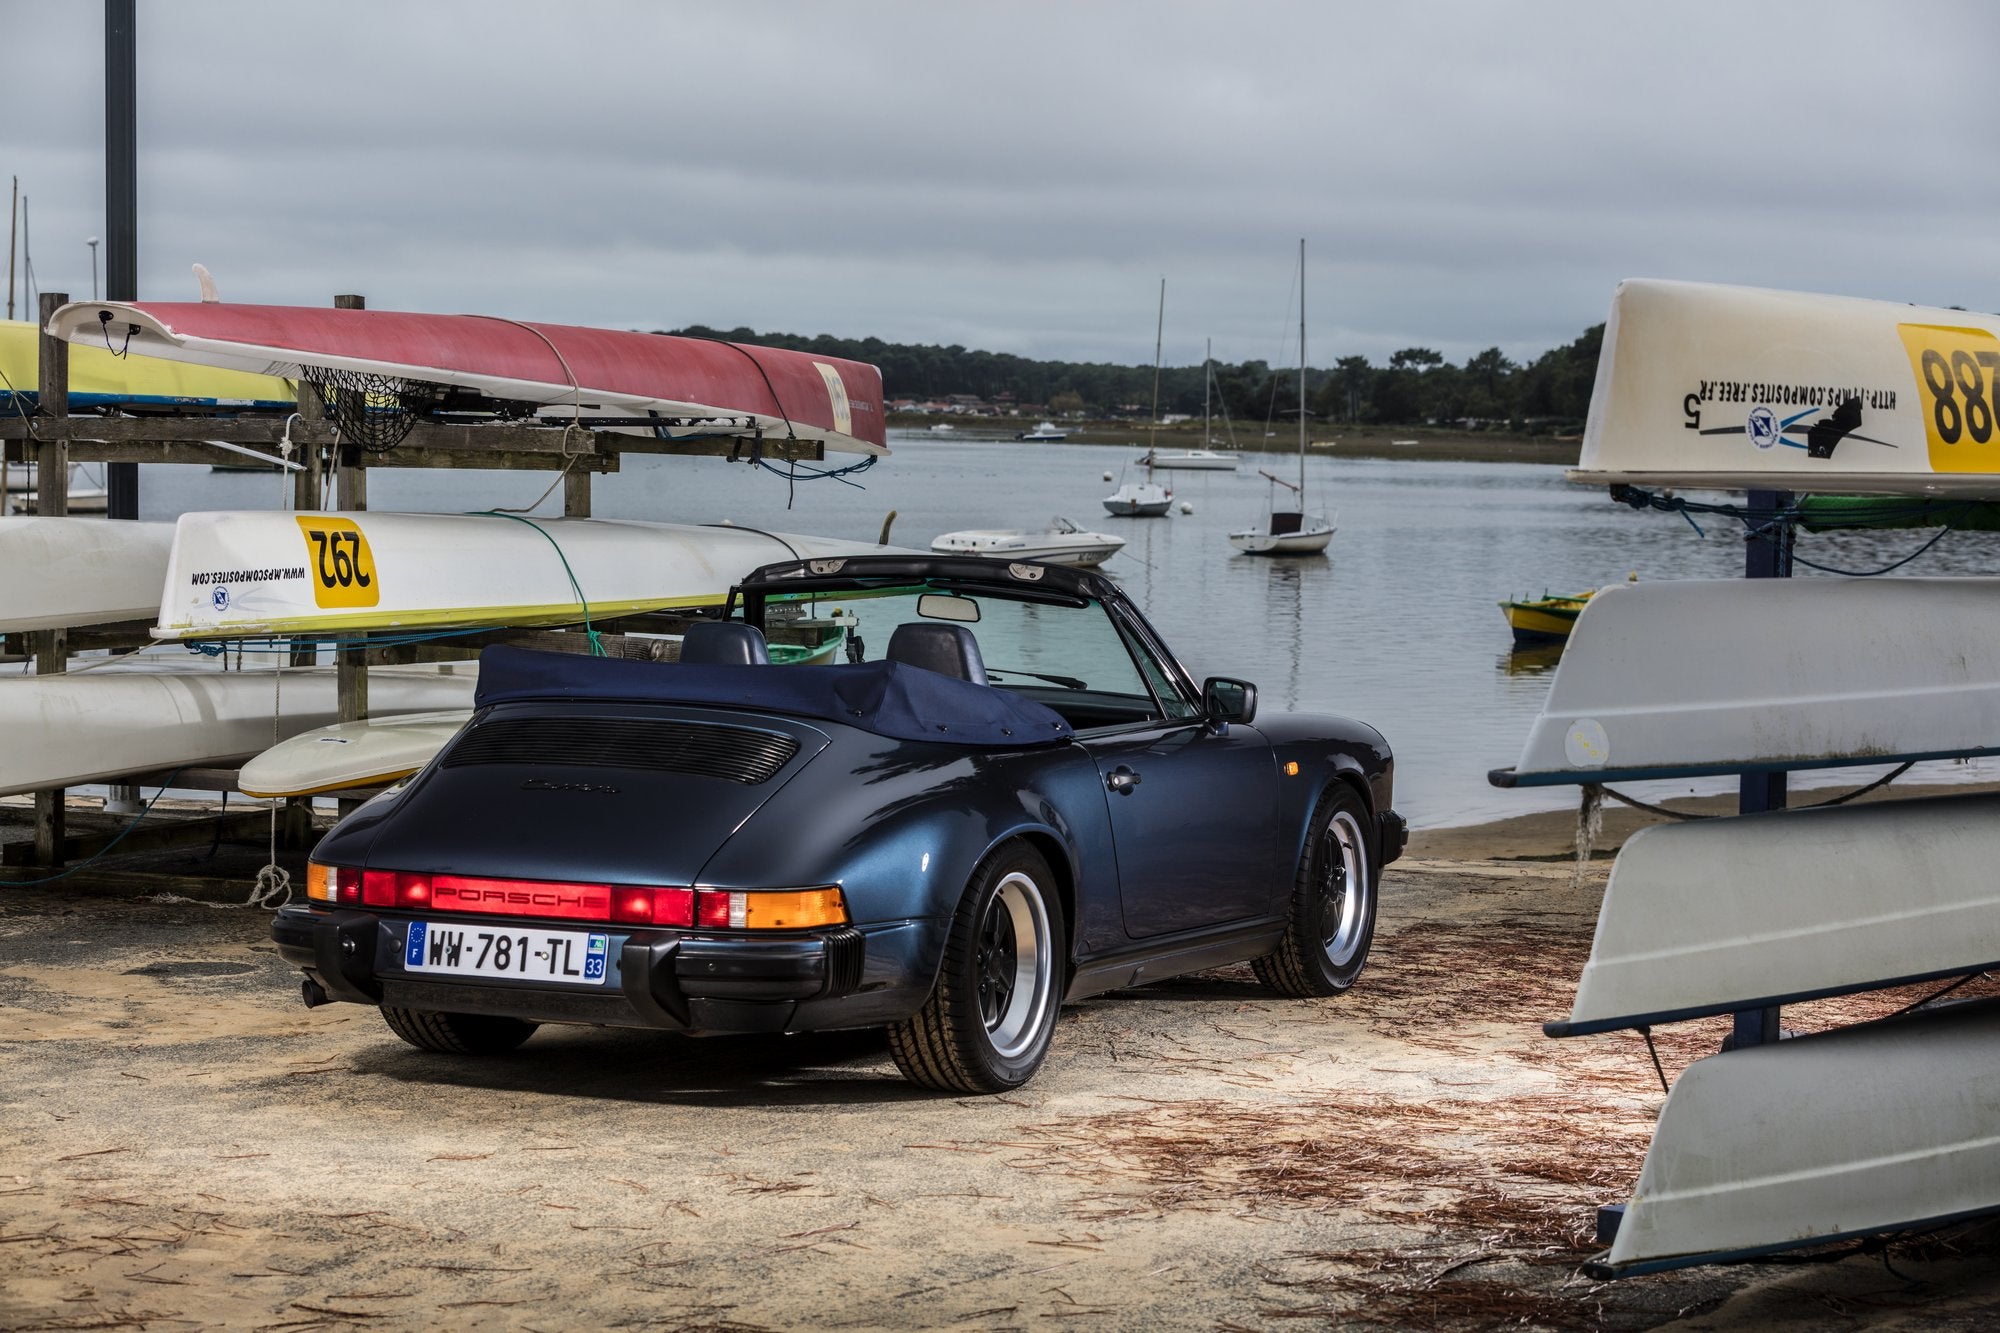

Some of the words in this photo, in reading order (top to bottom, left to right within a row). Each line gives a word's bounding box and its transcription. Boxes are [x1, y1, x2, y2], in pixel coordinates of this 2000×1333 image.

[1684, 393, 1702, 429] 5
[309, 530, 371, 588] 292
[191, 567, 305, 586] WWW.MPSCOMPOSITES.COM
[435, 887, 607, 909] PORSCHE
[412, 948, 419, 958] F
[429, 929, 580, 976] WW-781-TL
[586, 958, 603, 975] 33
